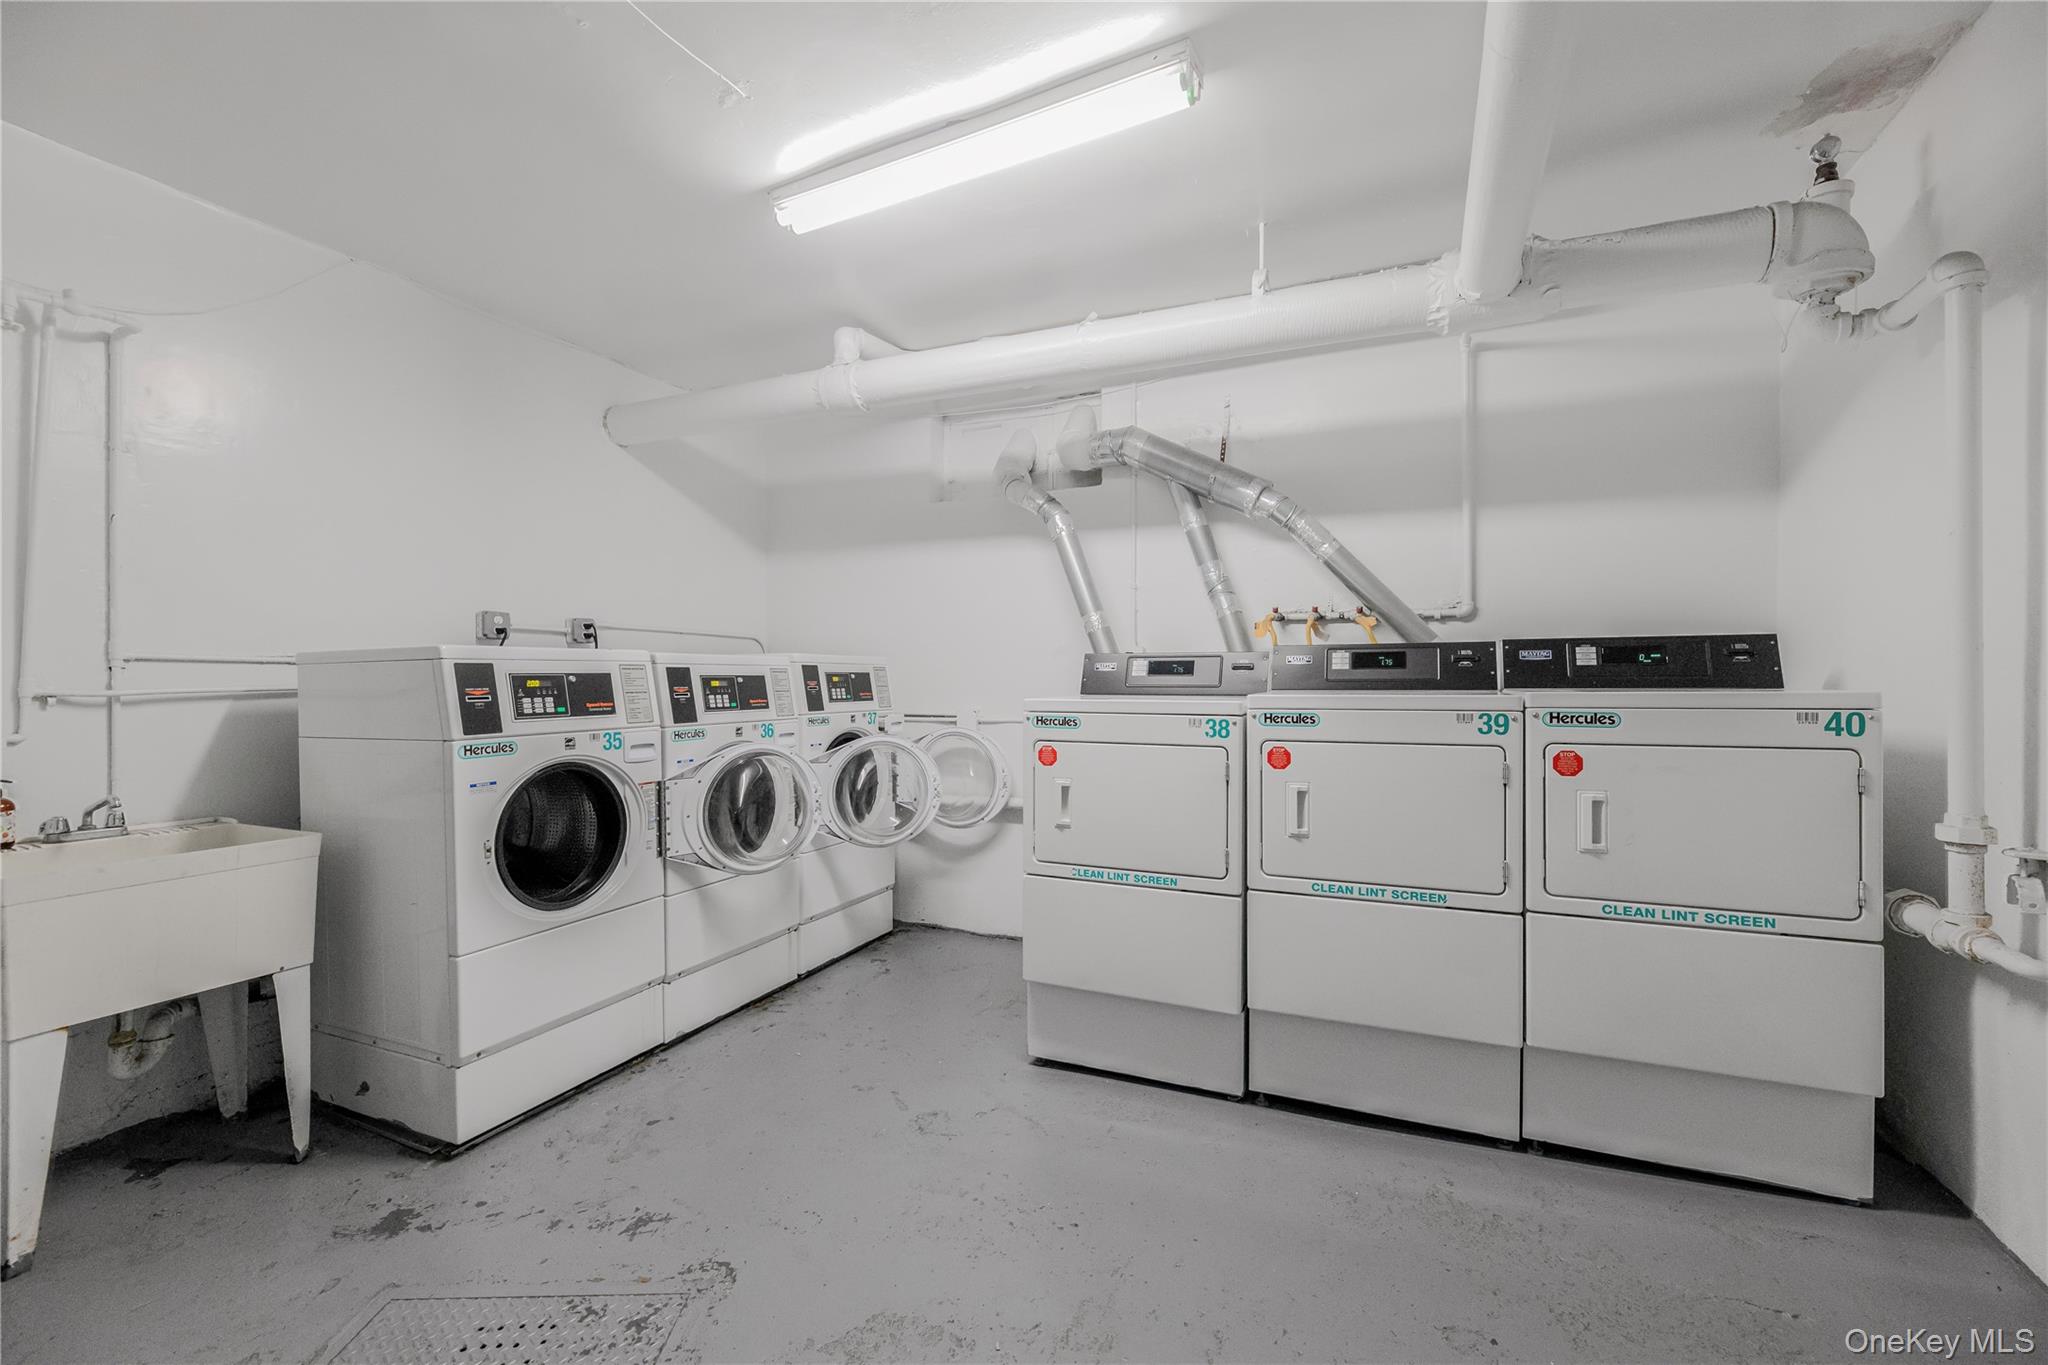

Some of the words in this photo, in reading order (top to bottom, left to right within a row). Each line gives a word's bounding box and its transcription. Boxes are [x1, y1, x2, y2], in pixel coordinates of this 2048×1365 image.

[867, 712, 877, 725] 37
[1035, 715, 1078, 727] Hercules
[1264, 712, 1316, 725] Hercules
[1477, 712, 1510, 736] 39
[1549, 711, 1616, 725] Hercules
[1823, 711, 1866, 737] 40
[673, 729, 705, 740] Hercules
[760, 723, 774, 738] 36
[1205, 718, 1231, 739] 38
[602, 731, 623, 751] 35
[463, 742, 514, 757] Hercules
[1107, 871, 1131, 882] LINT
[1133, 873, 1178, 887] SCREEN
[1311, 882, 1354, 895] CLEAN
[1358, 887, 1387, 898] LINT
[1391, 889, 1447, 904] SCREEN
[1601, 904, 1656, 919] CLEAN
[1661, 909, 1699, 923] LINT
[1703, 912, 1777, 929] SCREEN
